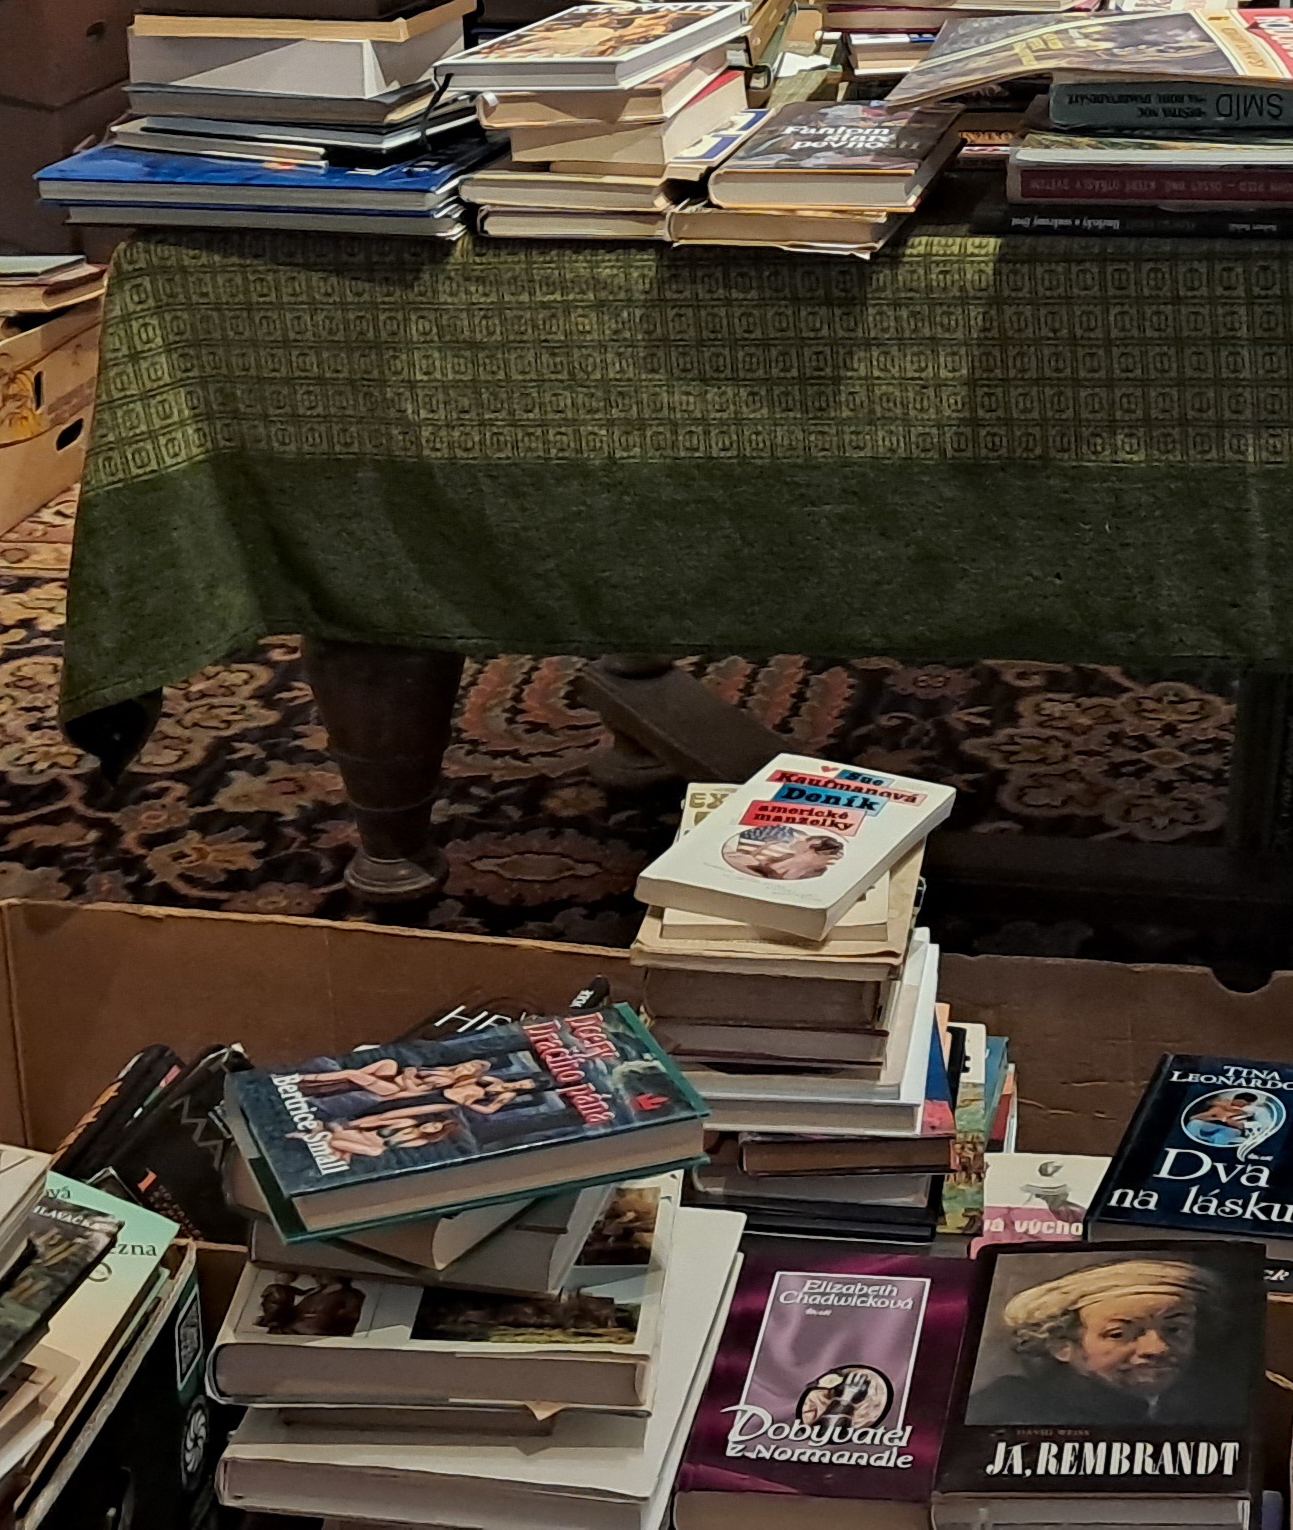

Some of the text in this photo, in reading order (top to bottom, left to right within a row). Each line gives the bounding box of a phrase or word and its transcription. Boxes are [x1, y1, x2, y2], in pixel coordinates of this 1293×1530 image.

[1215, 92, 1285, 122] ŠMÍD
[783, 124, 891, 137] Fantom
[778, 772, 919, 804] Kaufmanová
[843, 771, 885, 786] Sue
[757, 803, 851, 820] americké
[780, 786, 881, 812] Deník
[753, 811, 856, 831] manželky
[1222, 1065, 1281, 1081] TINA
[270, 1072, 351, 1176] Bertrice Small
[1152, 1146, 1271, 1189] Dva
[1106, 1186, 1160, 1212] na
[778, 1290, 915, 1311] Chadwicková
[802, 1279, 900, 1298] Elizabeth
[720, 1404, 913, 1447] Dobyvatel
[1035, 1441, 1241, 1476] REMBRANDT
